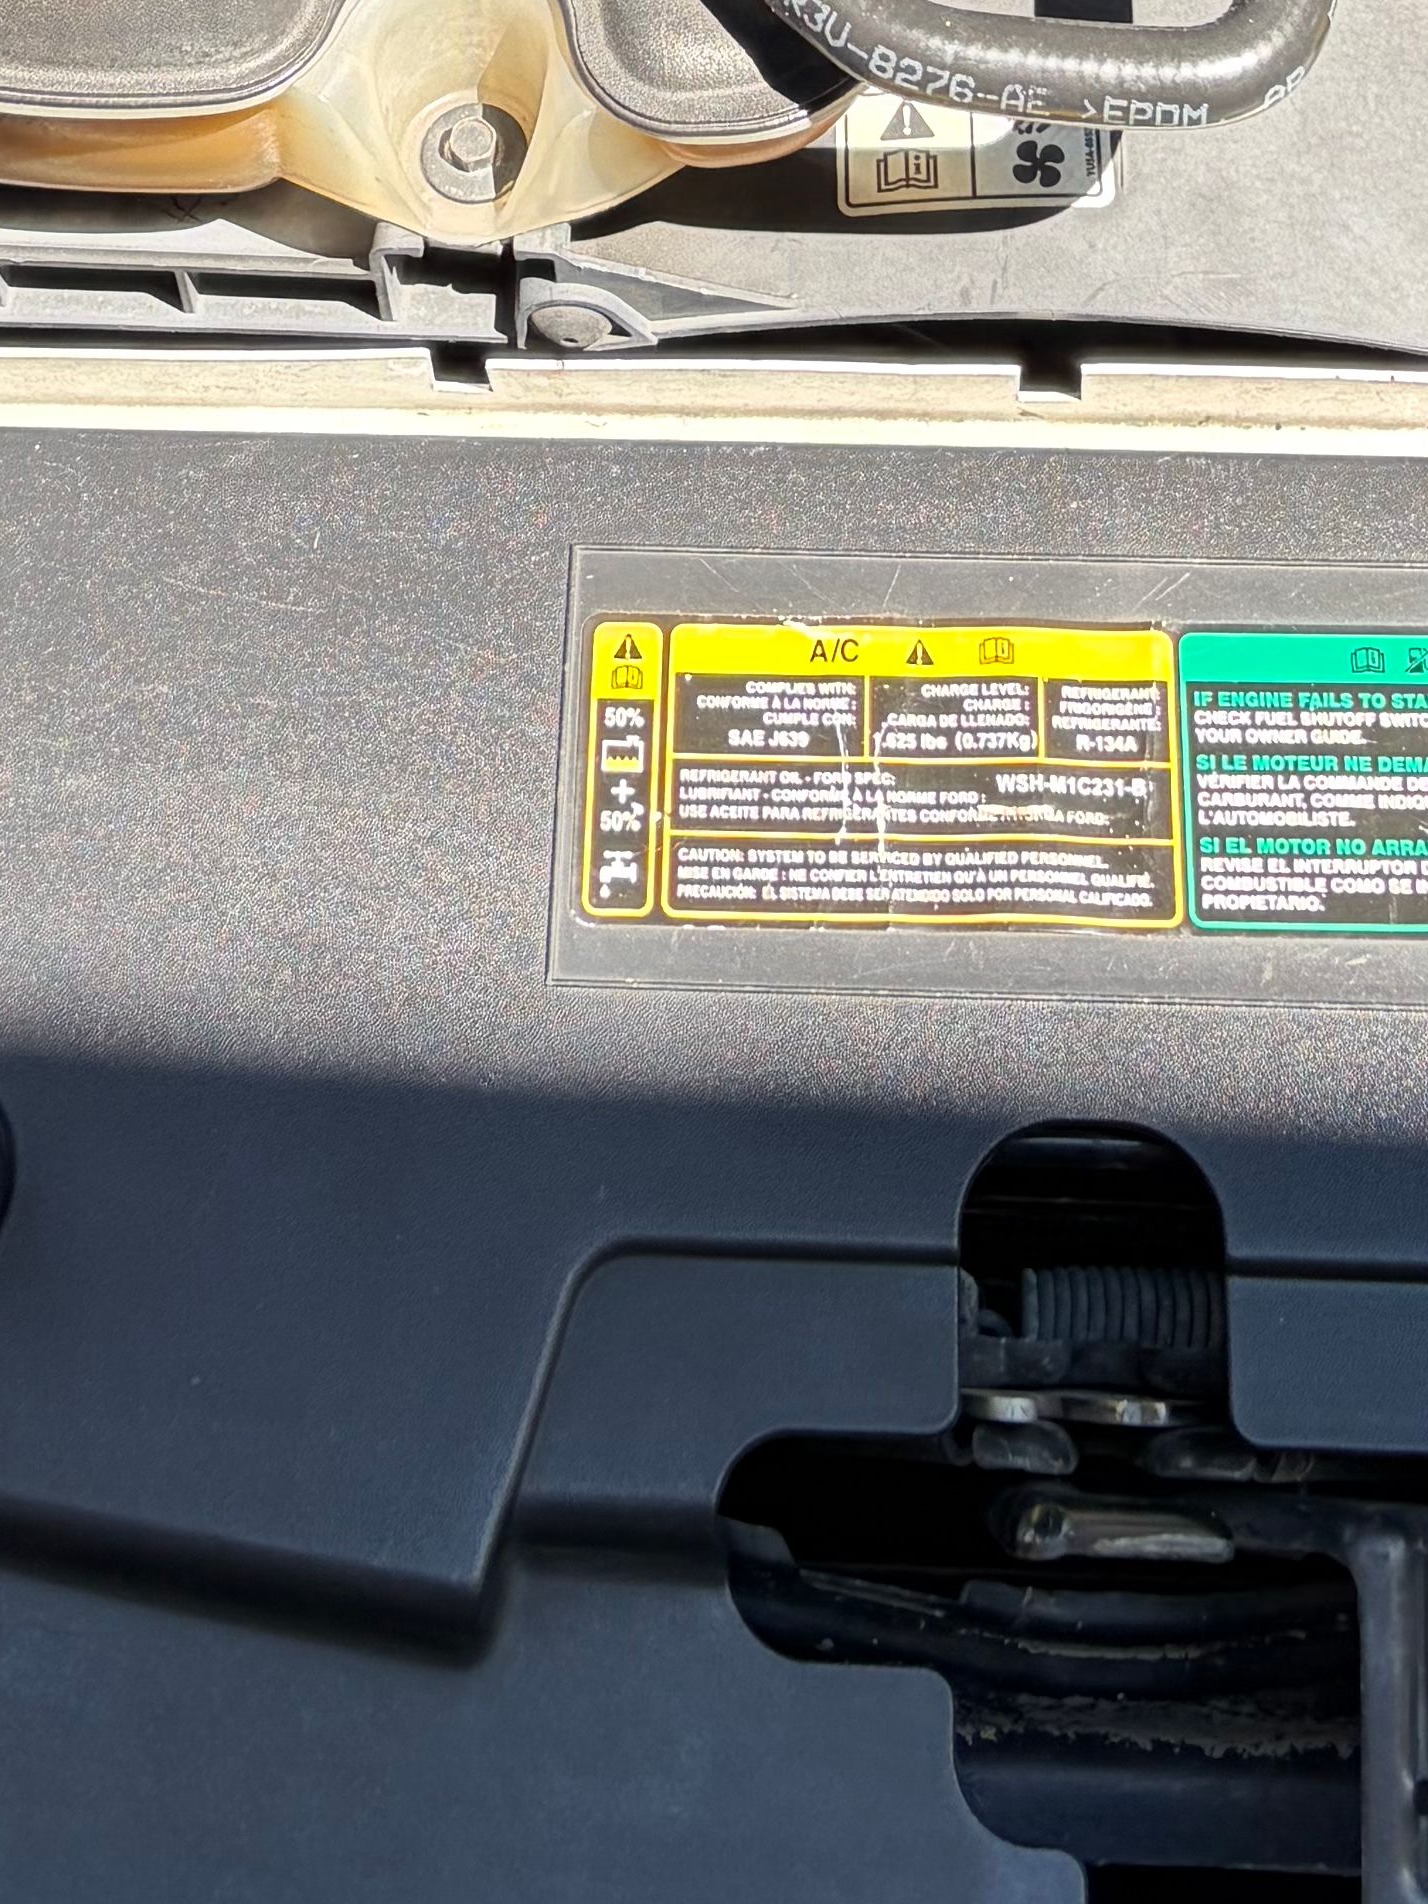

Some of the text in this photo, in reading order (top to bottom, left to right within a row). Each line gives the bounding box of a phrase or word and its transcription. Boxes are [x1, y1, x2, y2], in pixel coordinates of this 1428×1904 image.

[810, 638, 859, 663] A/C
[921, 683, 1030, 698] CHARGE LEVEL:
[696, 695, 770, 710] CONFORME
[783, 697, 802, 710] LA
[963, 698, 1019, 712] CHARGE
[1193, 690, 1212, 707] IF
[1218, 691, 1294, 708] ENGINE
[1298, 692, 1354, 709] FAILS
[1358, 693, 1387, 709] TO
[604, 706, 645, 728] 50%
[763, 711, 820, 726] CUMPLE
[886, 712, 938, 728] CARGA
[939, 712, 958, 727] DE
[1194, 710, 1251, 726] CHECK
[1255, 710, 1297, 726] FUEL
[1300, 711, 1377, 728] SHUTOFF
[728, 729, 766, 746] SAE
[921, 731, 948, 750] lbs
[1076, 734, 1138, 752] R-134A
[1194, 727, 1243, 744] YOUR
[1245, 728, 1308, 744] OWNER
[1195, 754, 1216, 771] SI
[1222, 754, 1247, 771] LE
[1252, 755, 1339, 772] MOTEUR
[1344, 755, 1373, 772] NE
[779, 771, 803, 785] OIL
[1277, 774, 1301, 790] LA
[1303, 774, 1403, 791] COMMANDE
[939, 791, 979, 805] FORD
[1310, 793, 1376, 809] COMME
[600, 810, 642, 832] 50%
[680, 805, 707, 819] USE
[709, 805, 759, 820] ACEITE
[762, 805, 801, 820] PARA
[1198, 810, 1356, 827] L'AUTOMOBILISTE.
[1200, 836, 1220, 854] SI
[1225, 837, 1252, 854] EL
[1257, 837, 1331, 855] MOTOR
[1336, 838, 1367, 855] NO
[678, 847, 745, 863] CAUTION:
[747, 848, 804, 863] SYSTEM
[807, 849, 826, 864] TO
[828, 849, 848, 864] BE
[922, 851, 943, 866] BY
[945, 851, 1019, 866] QUALIFIED
[1200, 857, 1264, 873] REVISE
[1267, 857, 1291, 874] EL
[1293, 858, 1417, 875] INTERRUPTOR
[712, 866, 731, 881] EN
[733, 866, 778, 881] GARDE
[789, 868, 808, 882] NE
[989, 870, 1008, 884] UN
[1200, 876, 1328, 893] COMBUSTIBLE
[1330, 877, 1386, 894] COMO
[1388, 878, 1414, 894] SE
[952, 888, 985, 902] SOLO
[987, 888, 1012, 902] POR
[1014, 888, 1078, 905] PERSONAL
[1201, 893, 1325, 911] PROPIETARIO.
